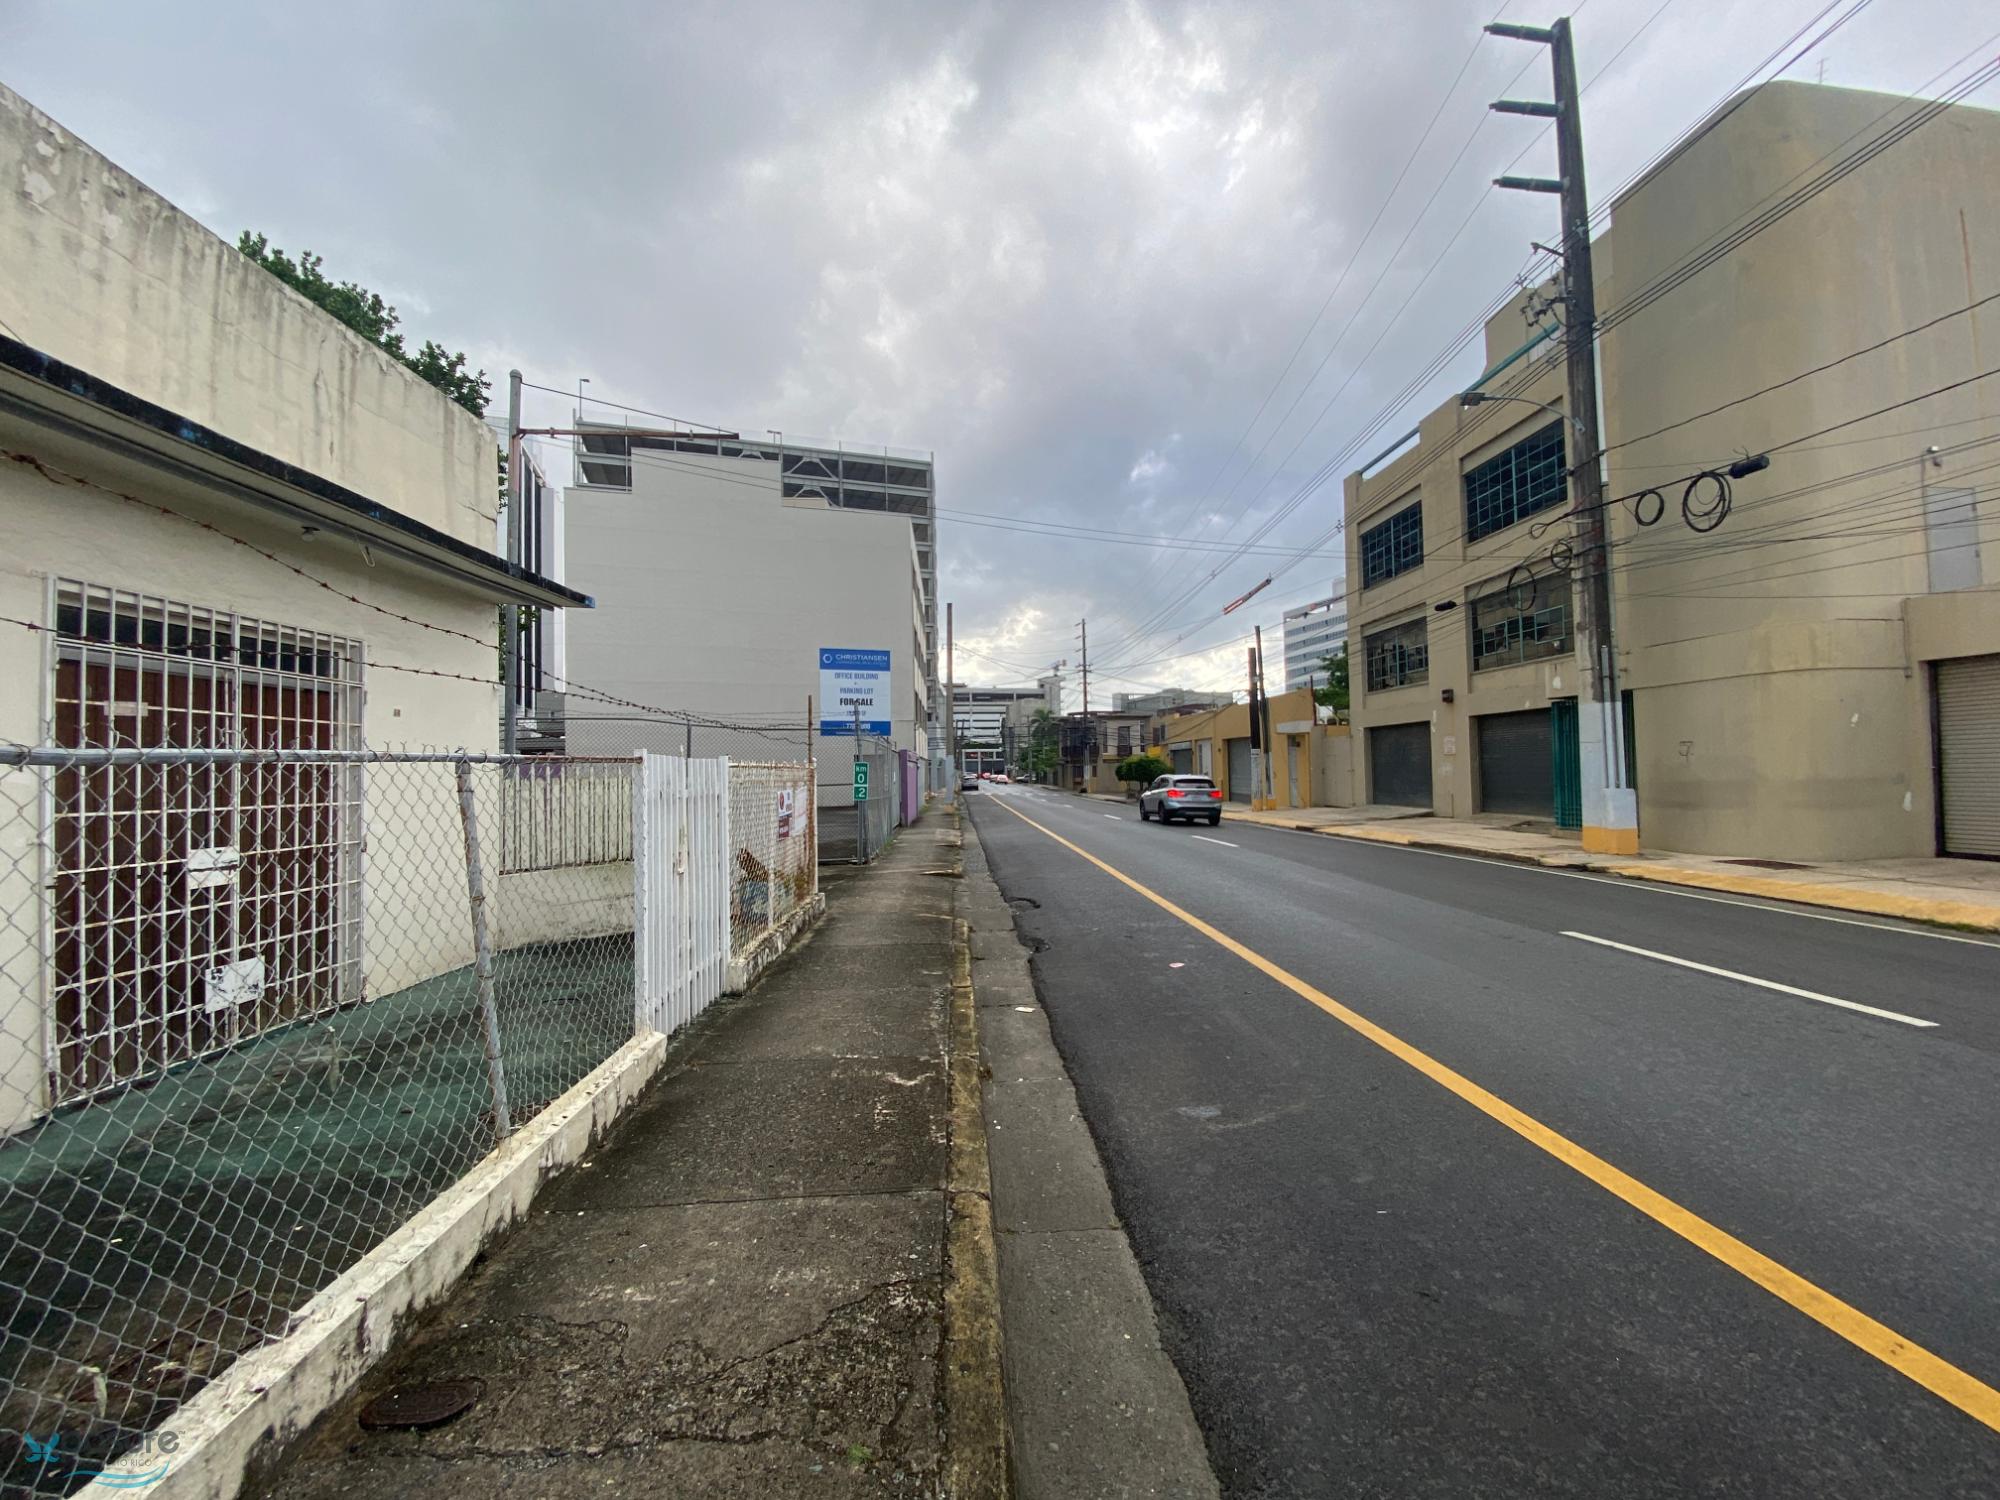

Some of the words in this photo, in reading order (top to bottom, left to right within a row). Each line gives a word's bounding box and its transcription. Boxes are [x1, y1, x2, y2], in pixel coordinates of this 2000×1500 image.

[854, 672, 879, 680] BUILDING
[839, 697, 854, 706] FOR
[855, 698, 874, 706] SALE
[857, 773, 865, 783] 0
